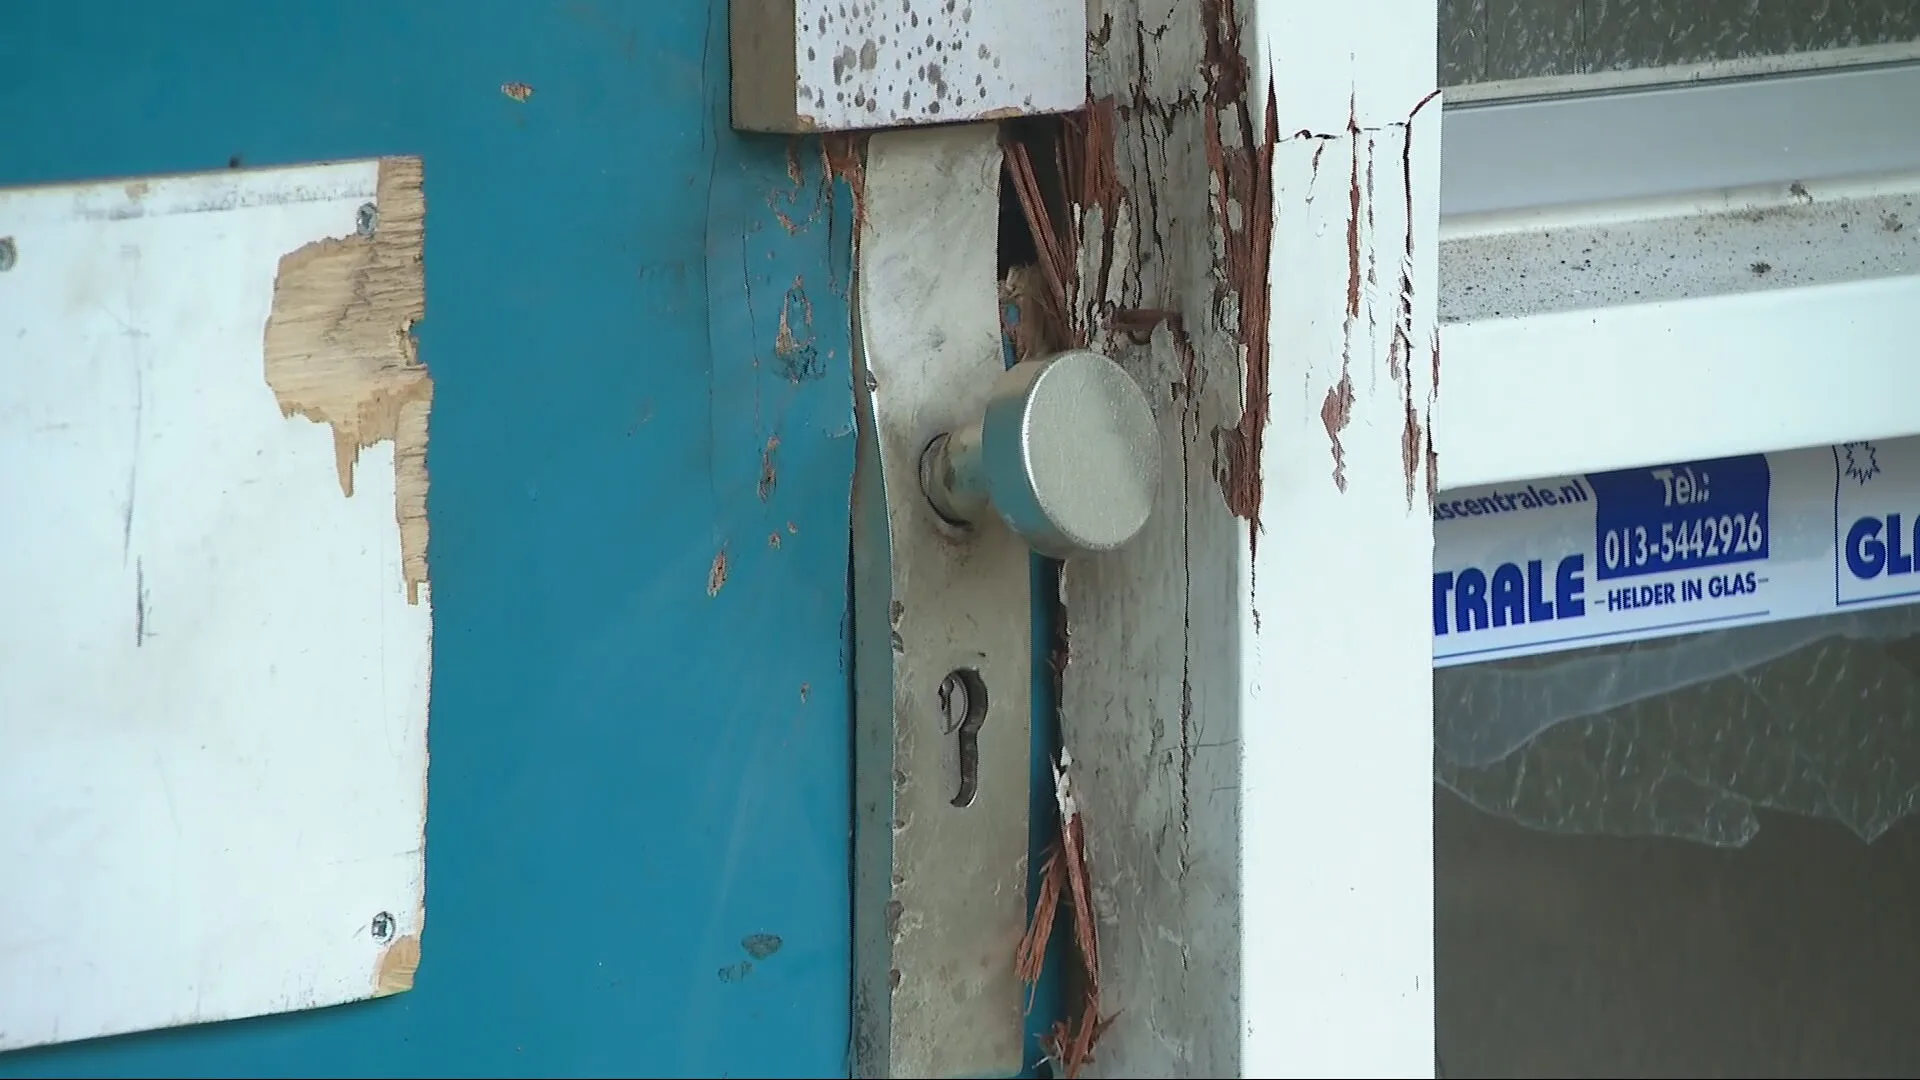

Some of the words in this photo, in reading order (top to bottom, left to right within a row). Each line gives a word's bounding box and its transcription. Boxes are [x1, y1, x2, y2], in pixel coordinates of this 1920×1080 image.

[1604, 511, 1764, 570] 013-5442926
[1845, 513, 1920, 580] GL
[1433, 553, 1586, 636] TRALE
[1681, 577, 1703, 602] IN
